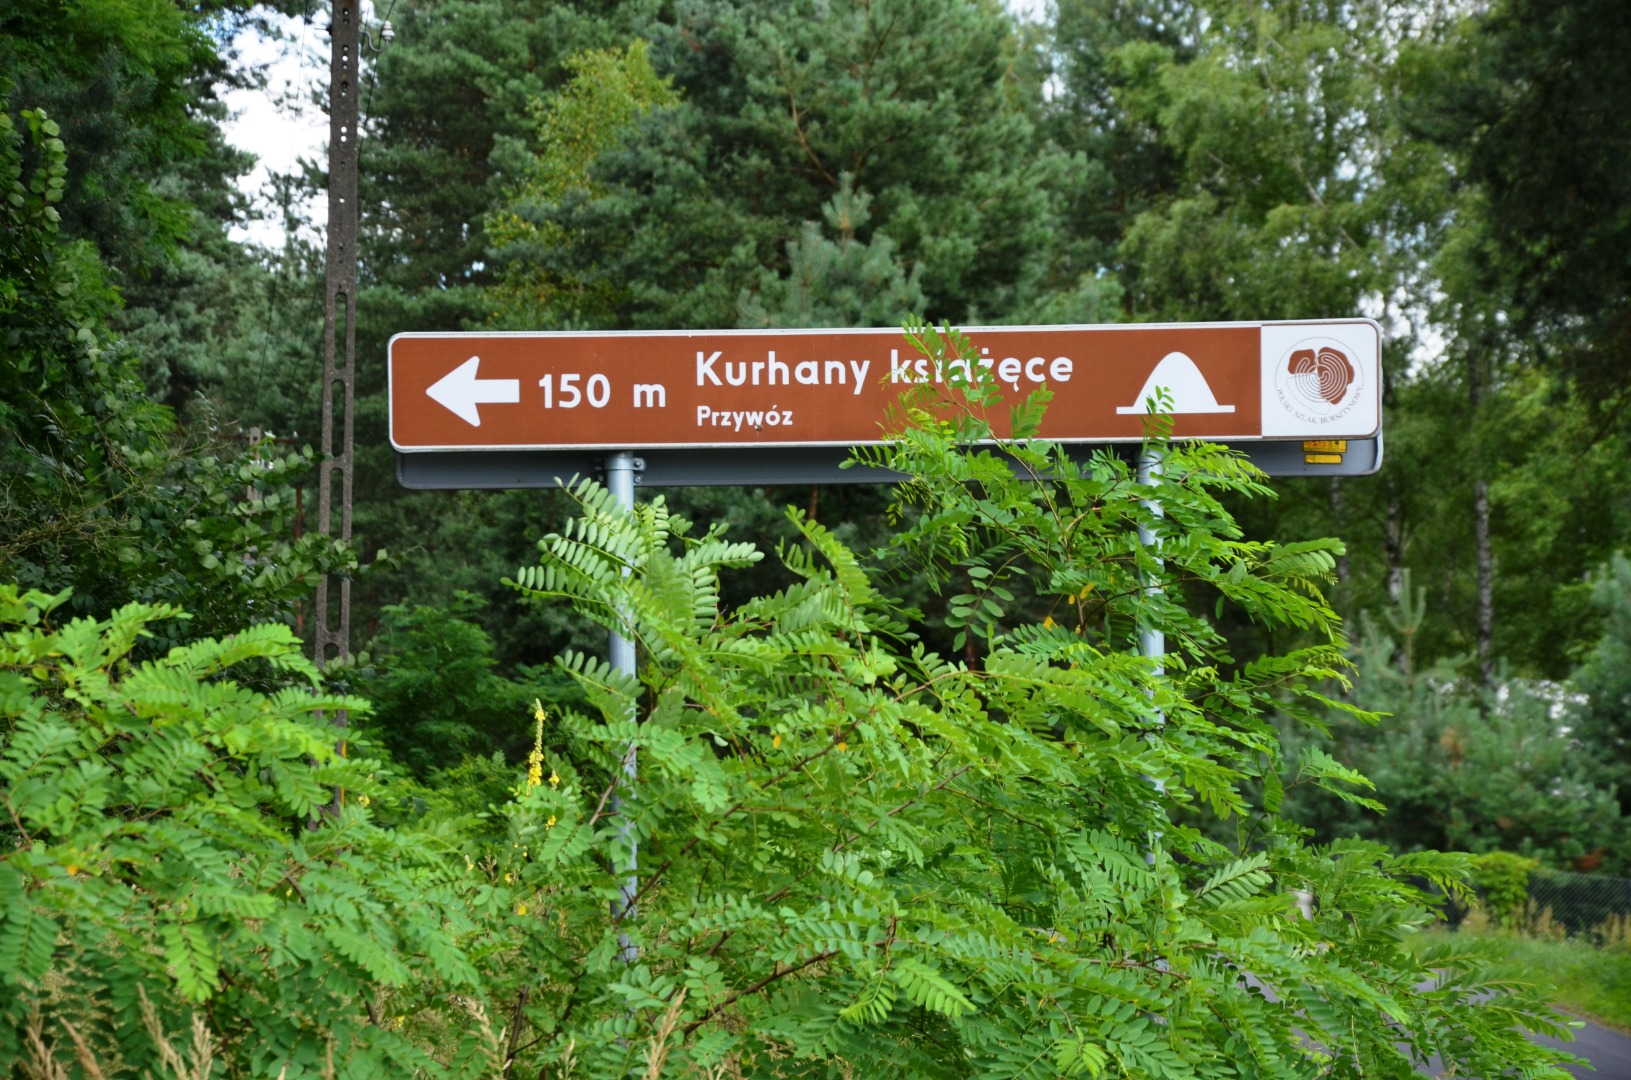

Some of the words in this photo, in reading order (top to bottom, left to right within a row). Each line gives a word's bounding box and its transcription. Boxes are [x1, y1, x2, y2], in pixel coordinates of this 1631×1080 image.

[695, 349, 871, 396] Kurhany
[538, 373, 611, 409] 150
[632, 382, 667, 409] m
[1275, 388, 1293, 414] POLSKI
[1294, 411, 1318, 424] SZLAK
[696, 404, 794, 432] Przywóz
